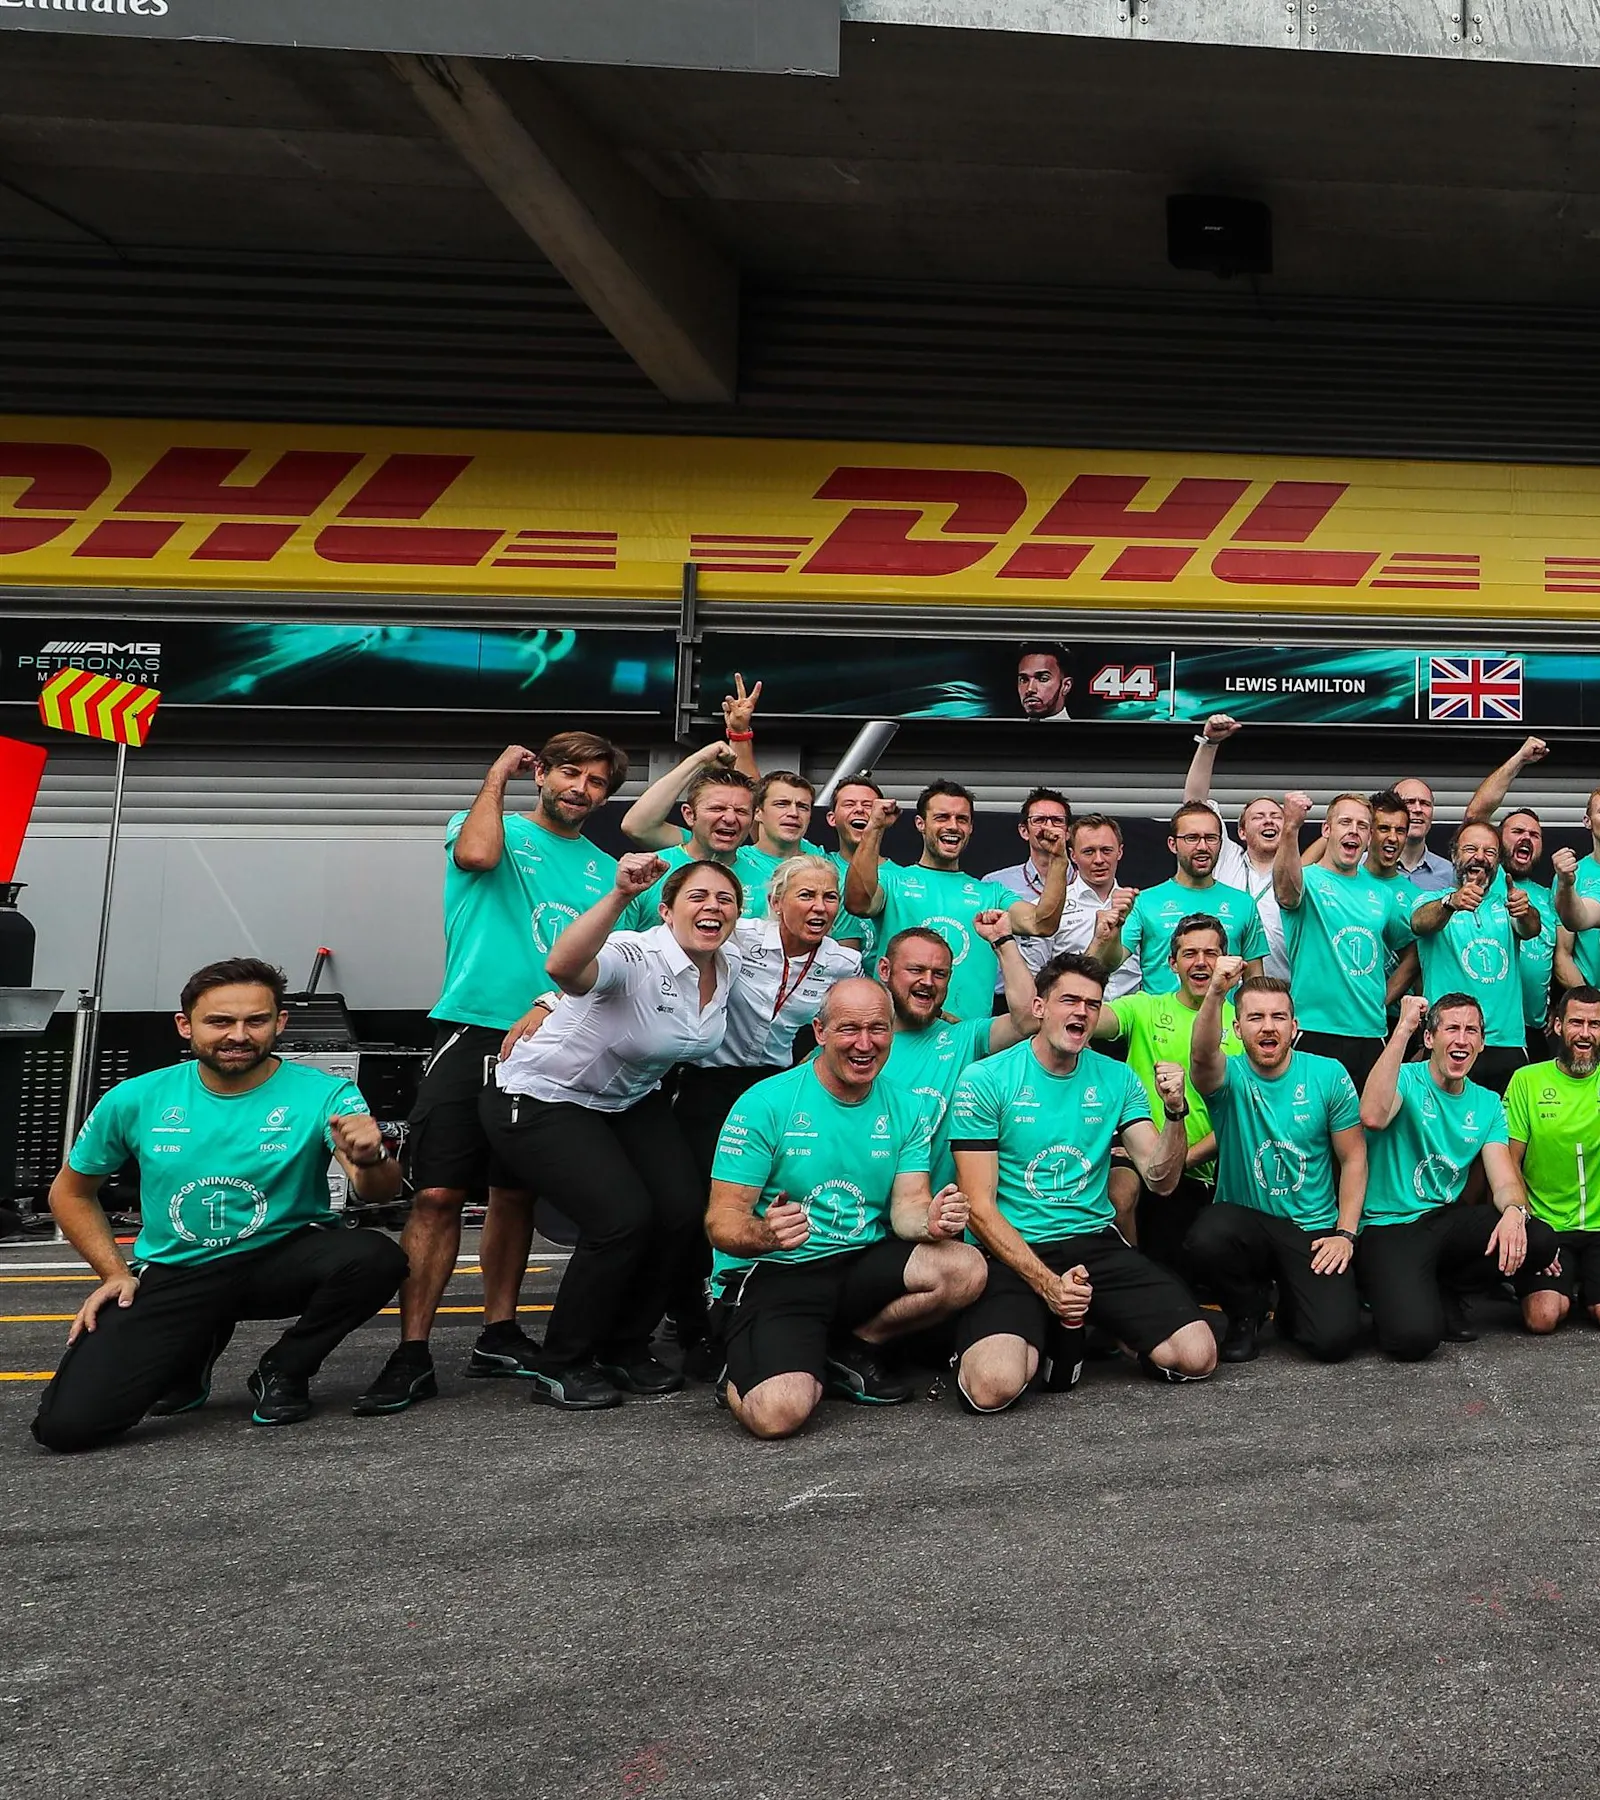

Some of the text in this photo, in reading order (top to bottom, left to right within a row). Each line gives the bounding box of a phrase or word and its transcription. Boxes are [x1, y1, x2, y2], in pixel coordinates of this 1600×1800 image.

[800, 466, 1381, 587] DHL
[18, 656, 160, 671] PETRONAS
[1090, 665, 1157, 700] 44
[1225, 677, 1366, 693] LEWIS HAMILTON
[547, 901, 581, 920] WINNER
[1349, 936, 1361, 966] 1
[723, 1125, 748, 1137] EPSON
[163, 1144, 182, 1153] UBS
[260, 1143, 287, 1151] BOSS
[796, 1148, 812, 1156] UBS
[1036, 1145, 1084, 1161] GP WINNERS
[1050, 1158, 1066, 1190] 1
[1273, 1153, 1286, 1182] 1
[180, 1176, 256, 1194] GP WINNERS
[811, 1179, 862, 1197] GP WINNERS
[1269, 1187, 1289, 1196] 2017
[201, 1190, 226, 1231] 1
[827, 1193, 845, 1227] 1
[202, 1237, 231, 1247] 2017
